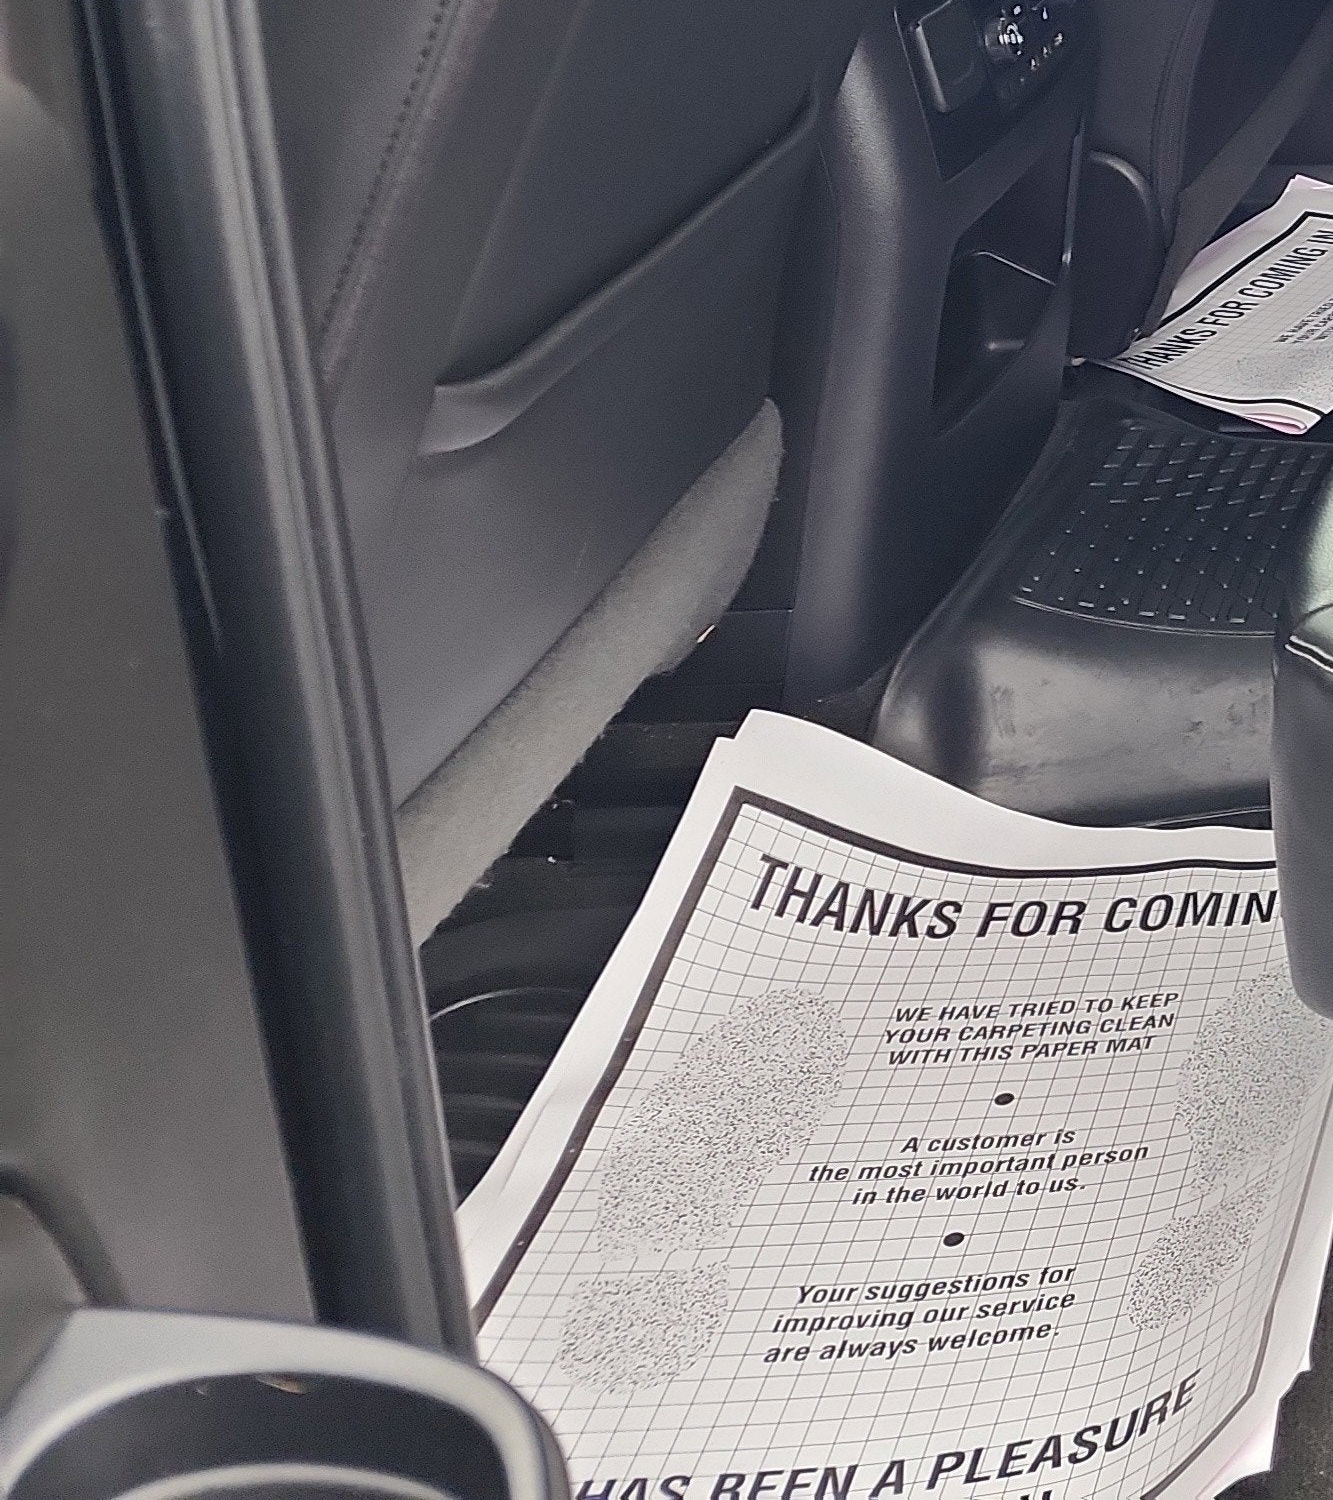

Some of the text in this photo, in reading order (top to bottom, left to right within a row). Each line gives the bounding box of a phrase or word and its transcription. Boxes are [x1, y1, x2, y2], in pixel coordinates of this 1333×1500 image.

[1116, 328, 1218, 370] THANKS
[1196, 300, 1259, 327] FOR
[1238, 247, 1328, 299] COMING
[748, 854, 964, 939] THANKS
[976, 900, 1087, 939] FOR
[895, 992, 1180, 1023] WE HAVE TRIED TO KEEP
[885, 1013, 1176, 1045] YOUR CARPETING CLEAN
[888, 1034, 1157, 1066] WITH THIS PAPER MAT
[900, 1128, 1076, 1155] A customer is
[808, 1145, 1150, 1184] the most important person
[851, 1176, 1087, 1206] in the world to us.
[797, 1265, 1077, 1305] Your suggestions for
[771, 1290, 1077, 1336] improving our service
[762, 1320, 1060, 1364] are always welcome.
[575, 1367, 1203, 1500] HAS BEEN A PLEASURE
